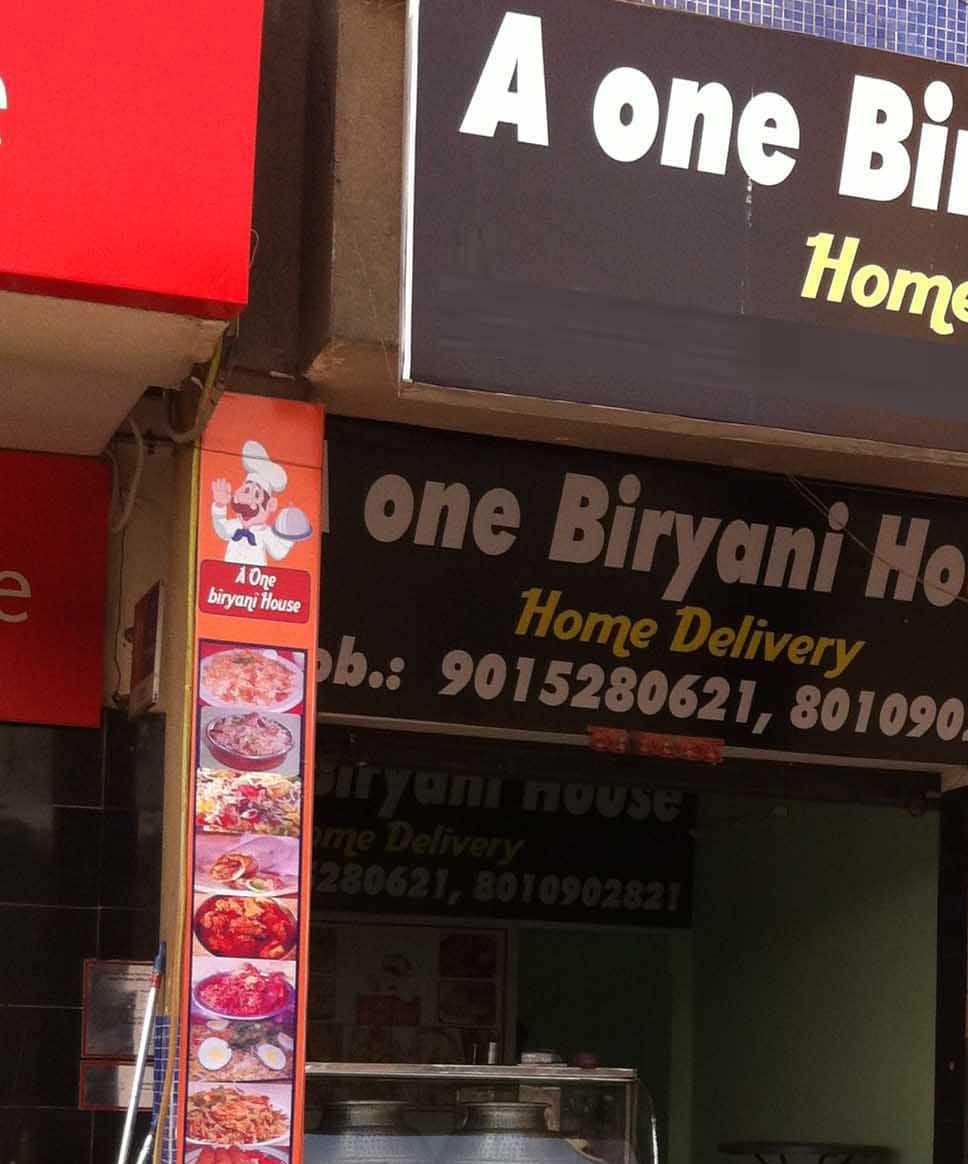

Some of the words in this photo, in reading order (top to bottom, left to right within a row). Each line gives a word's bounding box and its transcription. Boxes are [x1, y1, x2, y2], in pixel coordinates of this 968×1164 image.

[459, 12, 549, 147] A
[593, 67, 800, 186] one
[364, 474, 521, 556] one
[549, 472, 849, 602] Biryani
[207, 586, 260, 613] biryani
[260, 591, 302, 614] House
[234, 565, 246, 585] A
[249, 567, 277, 591] One
[515, 587, 658, 658] Home
[670, 605, 866, 679] Delivery
[316, 634, 405, 691] ob.:
[438, 649, 774, 735] 9015280621,
[521, 780, 683, 823] House
[384, 821, 526, 865] Delivery
[314, 861, 462, 905] 280621,
[473, 869, 682, 911] 8010902821
